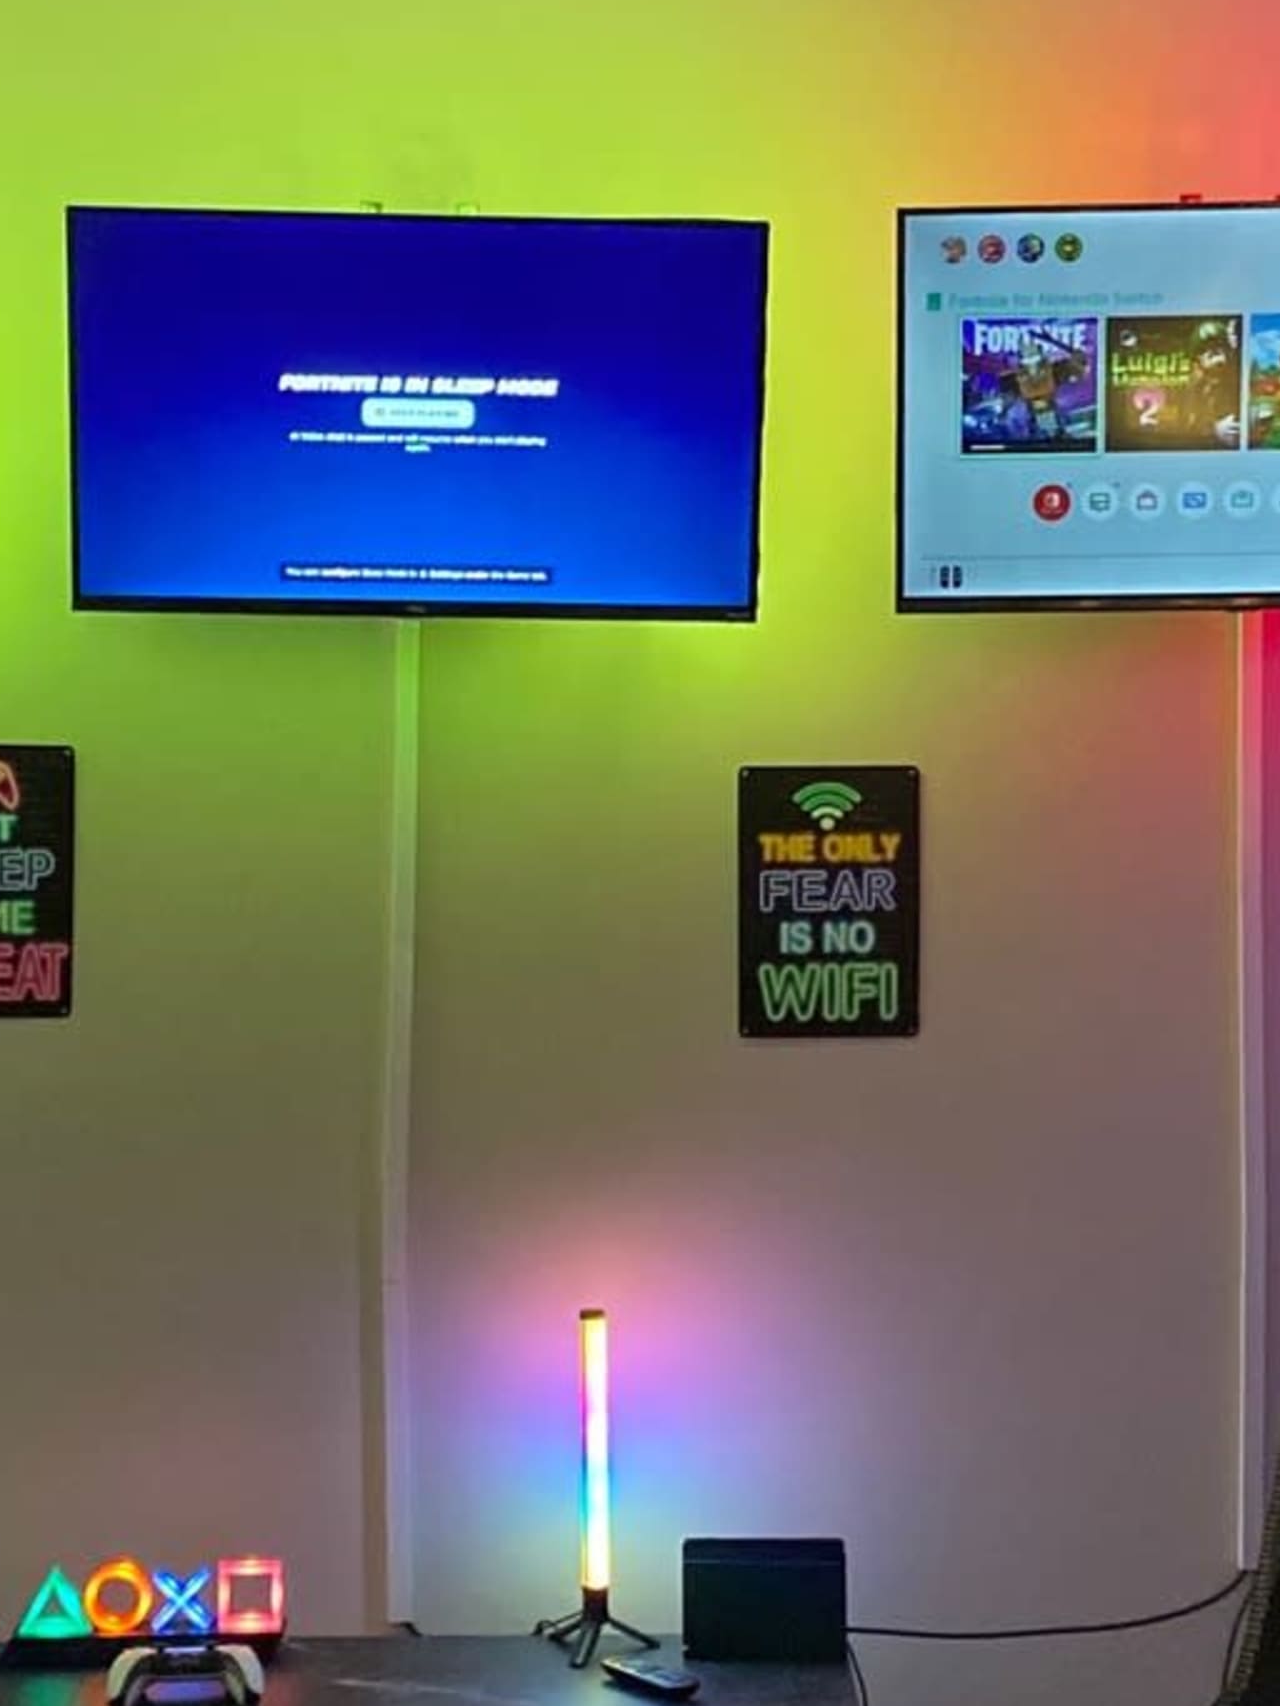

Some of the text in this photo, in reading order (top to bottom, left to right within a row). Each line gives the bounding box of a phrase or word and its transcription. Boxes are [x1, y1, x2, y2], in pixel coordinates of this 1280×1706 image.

[758, 833, 902, 864] THE ONLY
[759, 869, 897, 913] FEAR
[778, 921, 876, 955] IS NO
[758, 961, 900, 1022] WIFI
